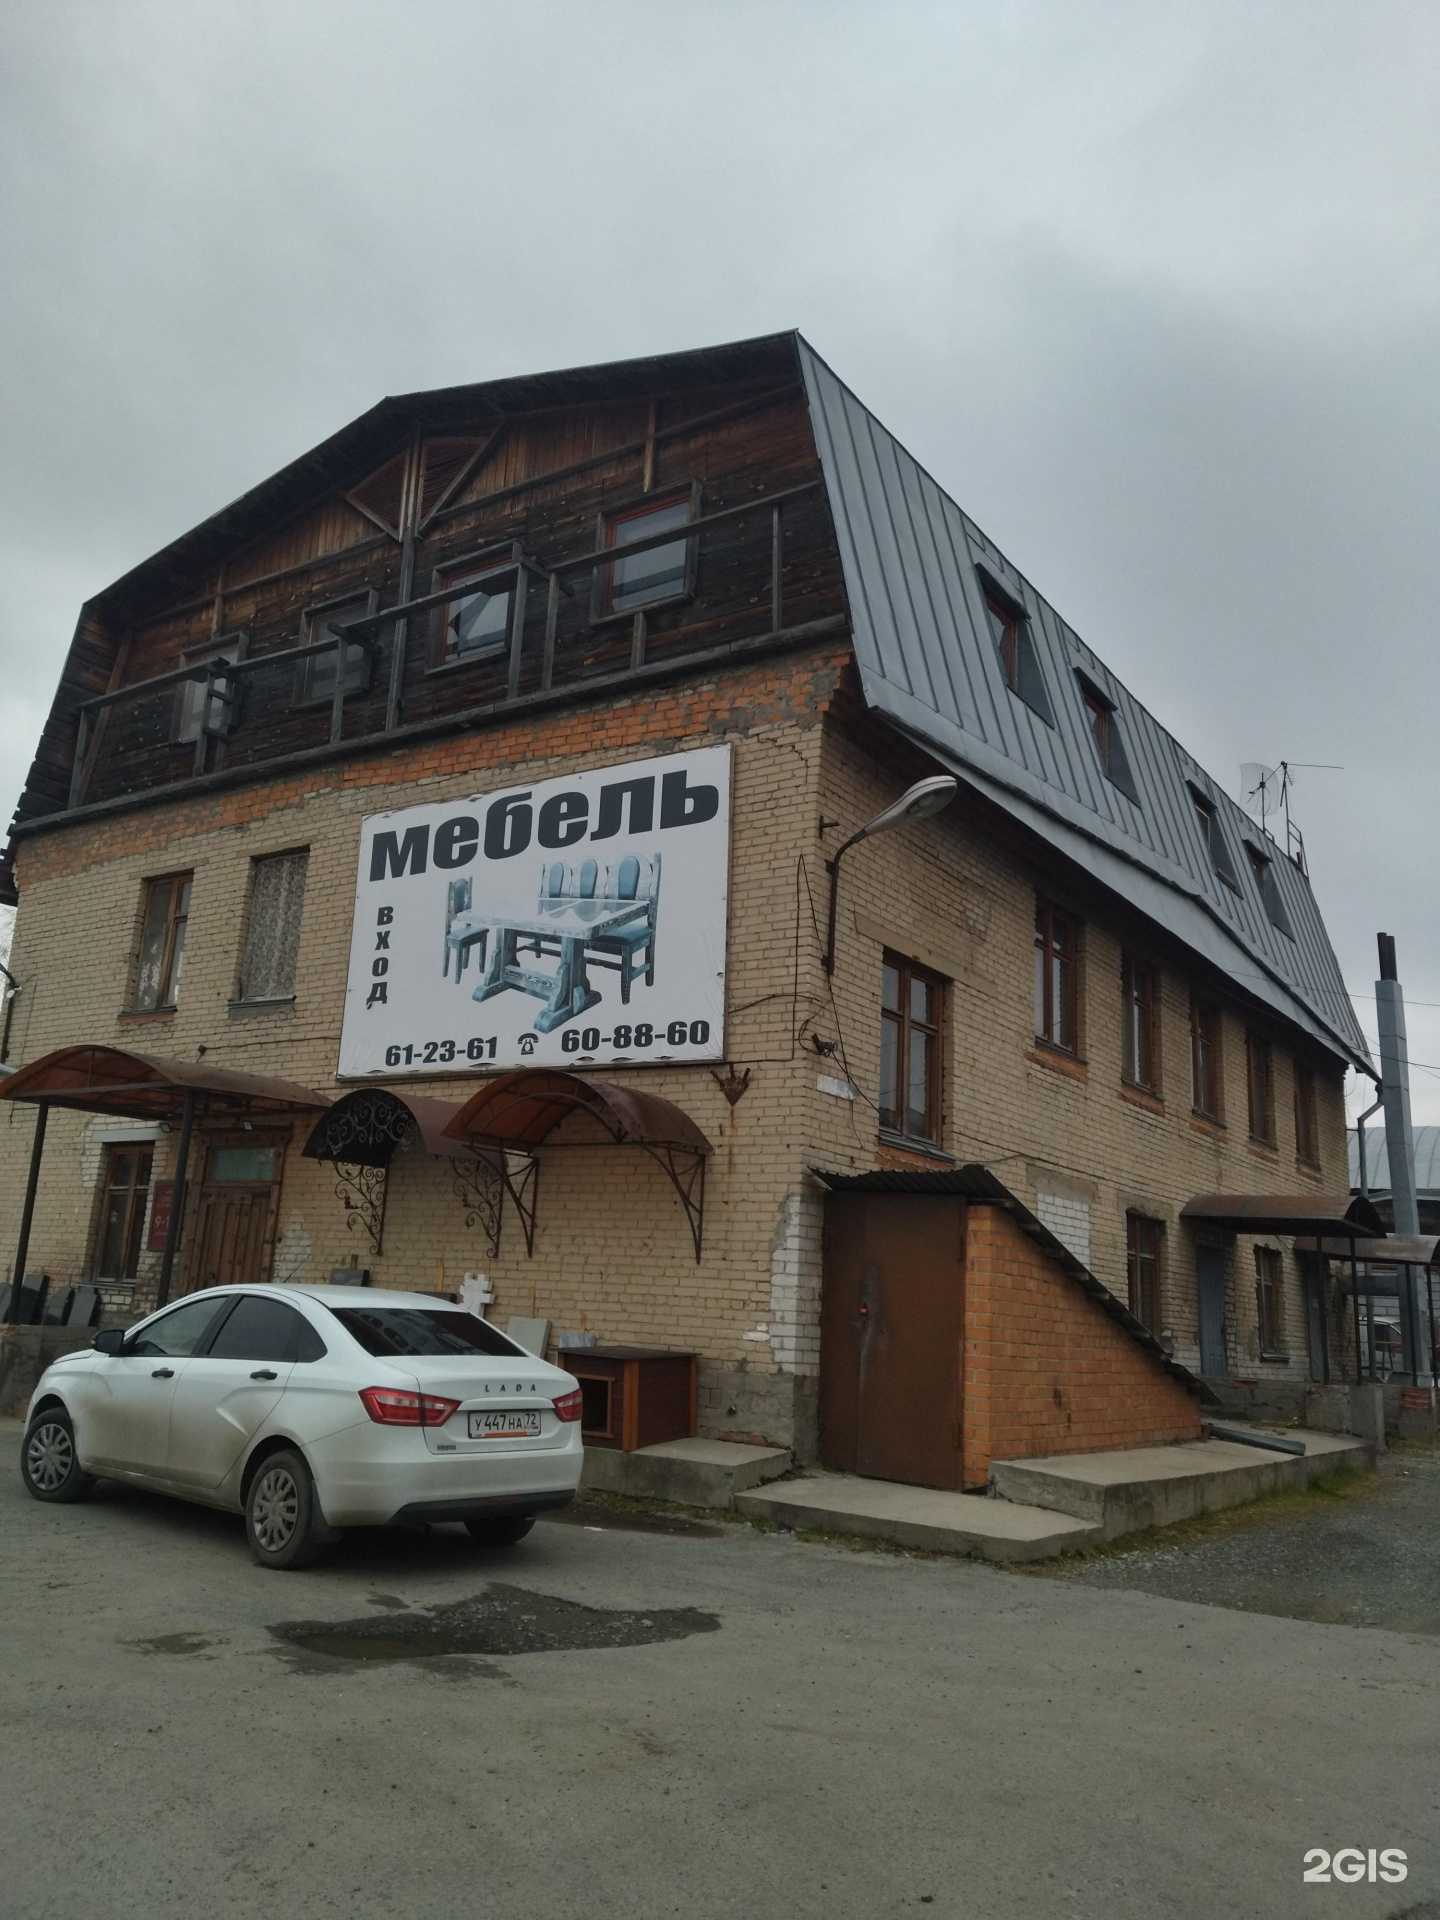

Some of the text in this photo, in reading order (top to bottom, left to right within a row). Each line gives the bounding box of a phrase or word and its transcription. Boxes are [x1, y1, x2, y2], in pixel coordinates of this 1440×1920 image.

[385, 1019, 711, 1067] 61-23-61 60-88-60
[484, 1383, 537, 1393] LADA
